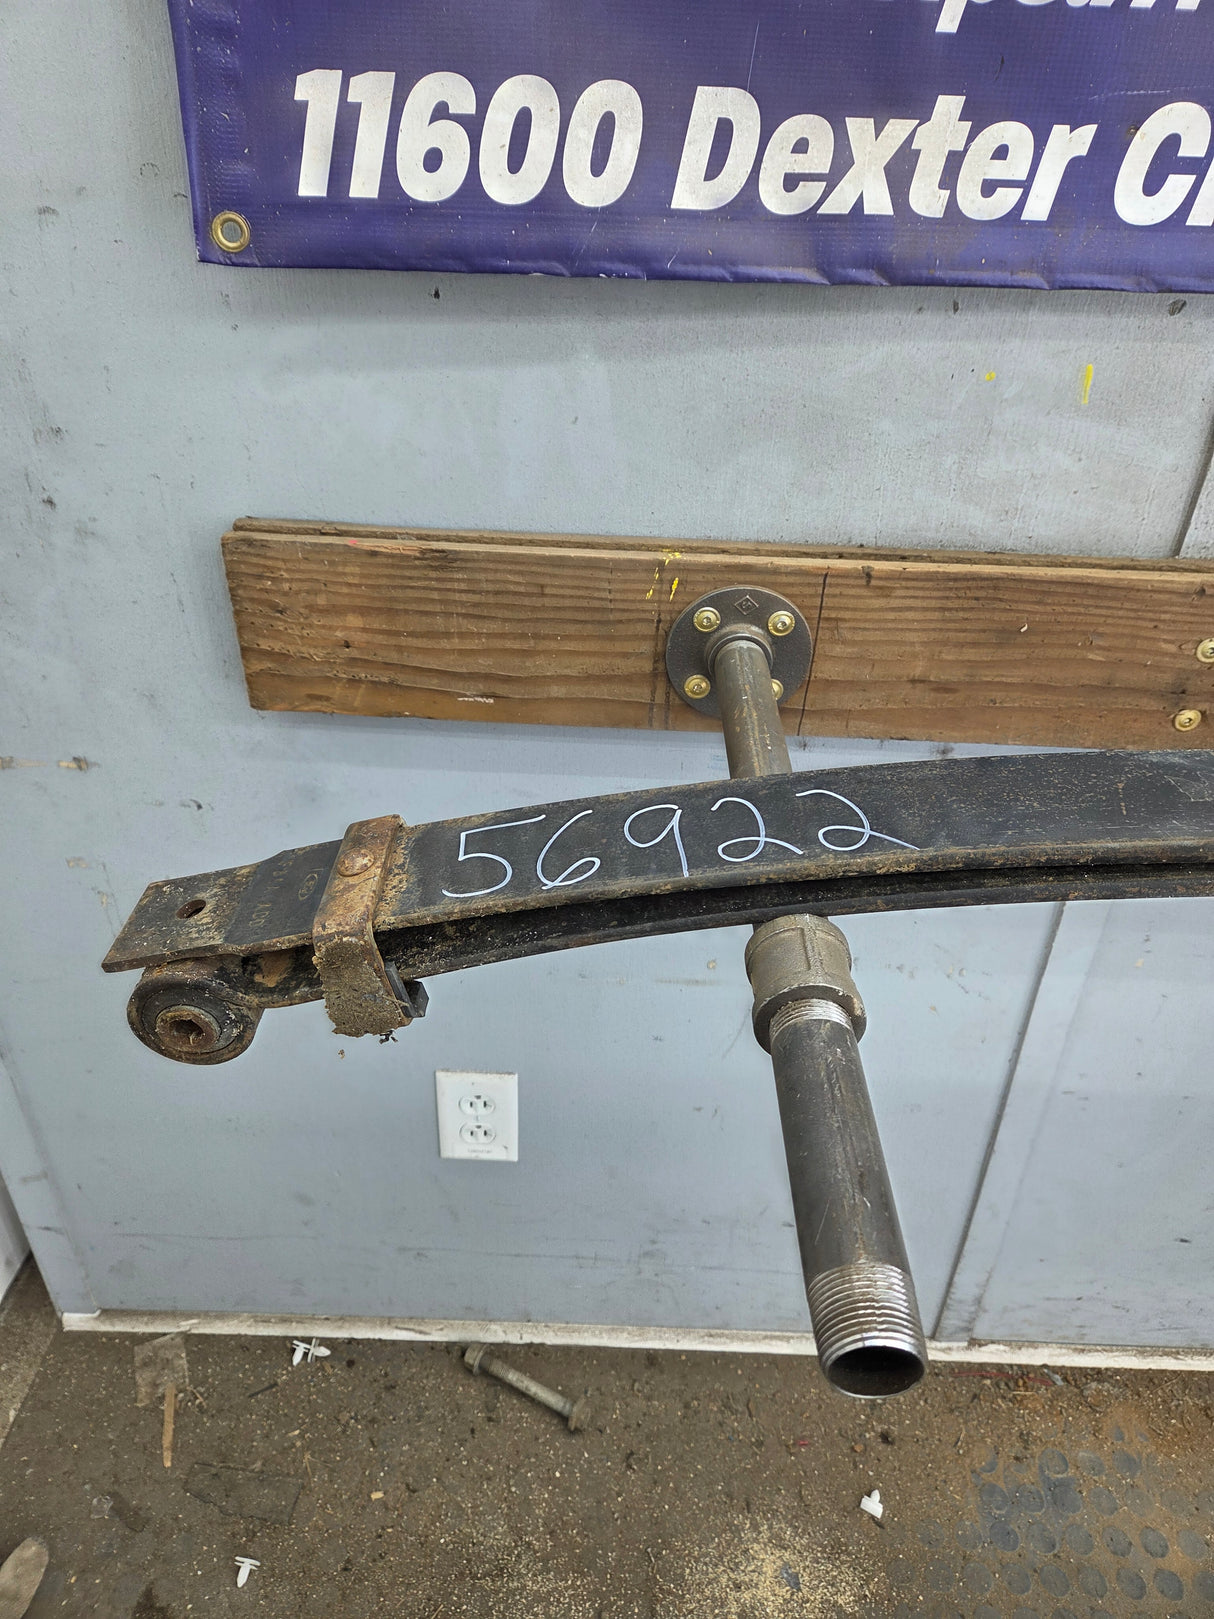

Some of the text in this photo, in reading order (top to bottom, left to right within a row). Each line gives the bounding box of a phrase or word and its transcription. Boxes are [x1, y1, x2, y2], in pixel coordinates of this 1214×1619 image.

[294, 69, 644, 208] 11600
[671, 85, 1098, 222] Dexter
[441, 789, 921, 898] 56922
